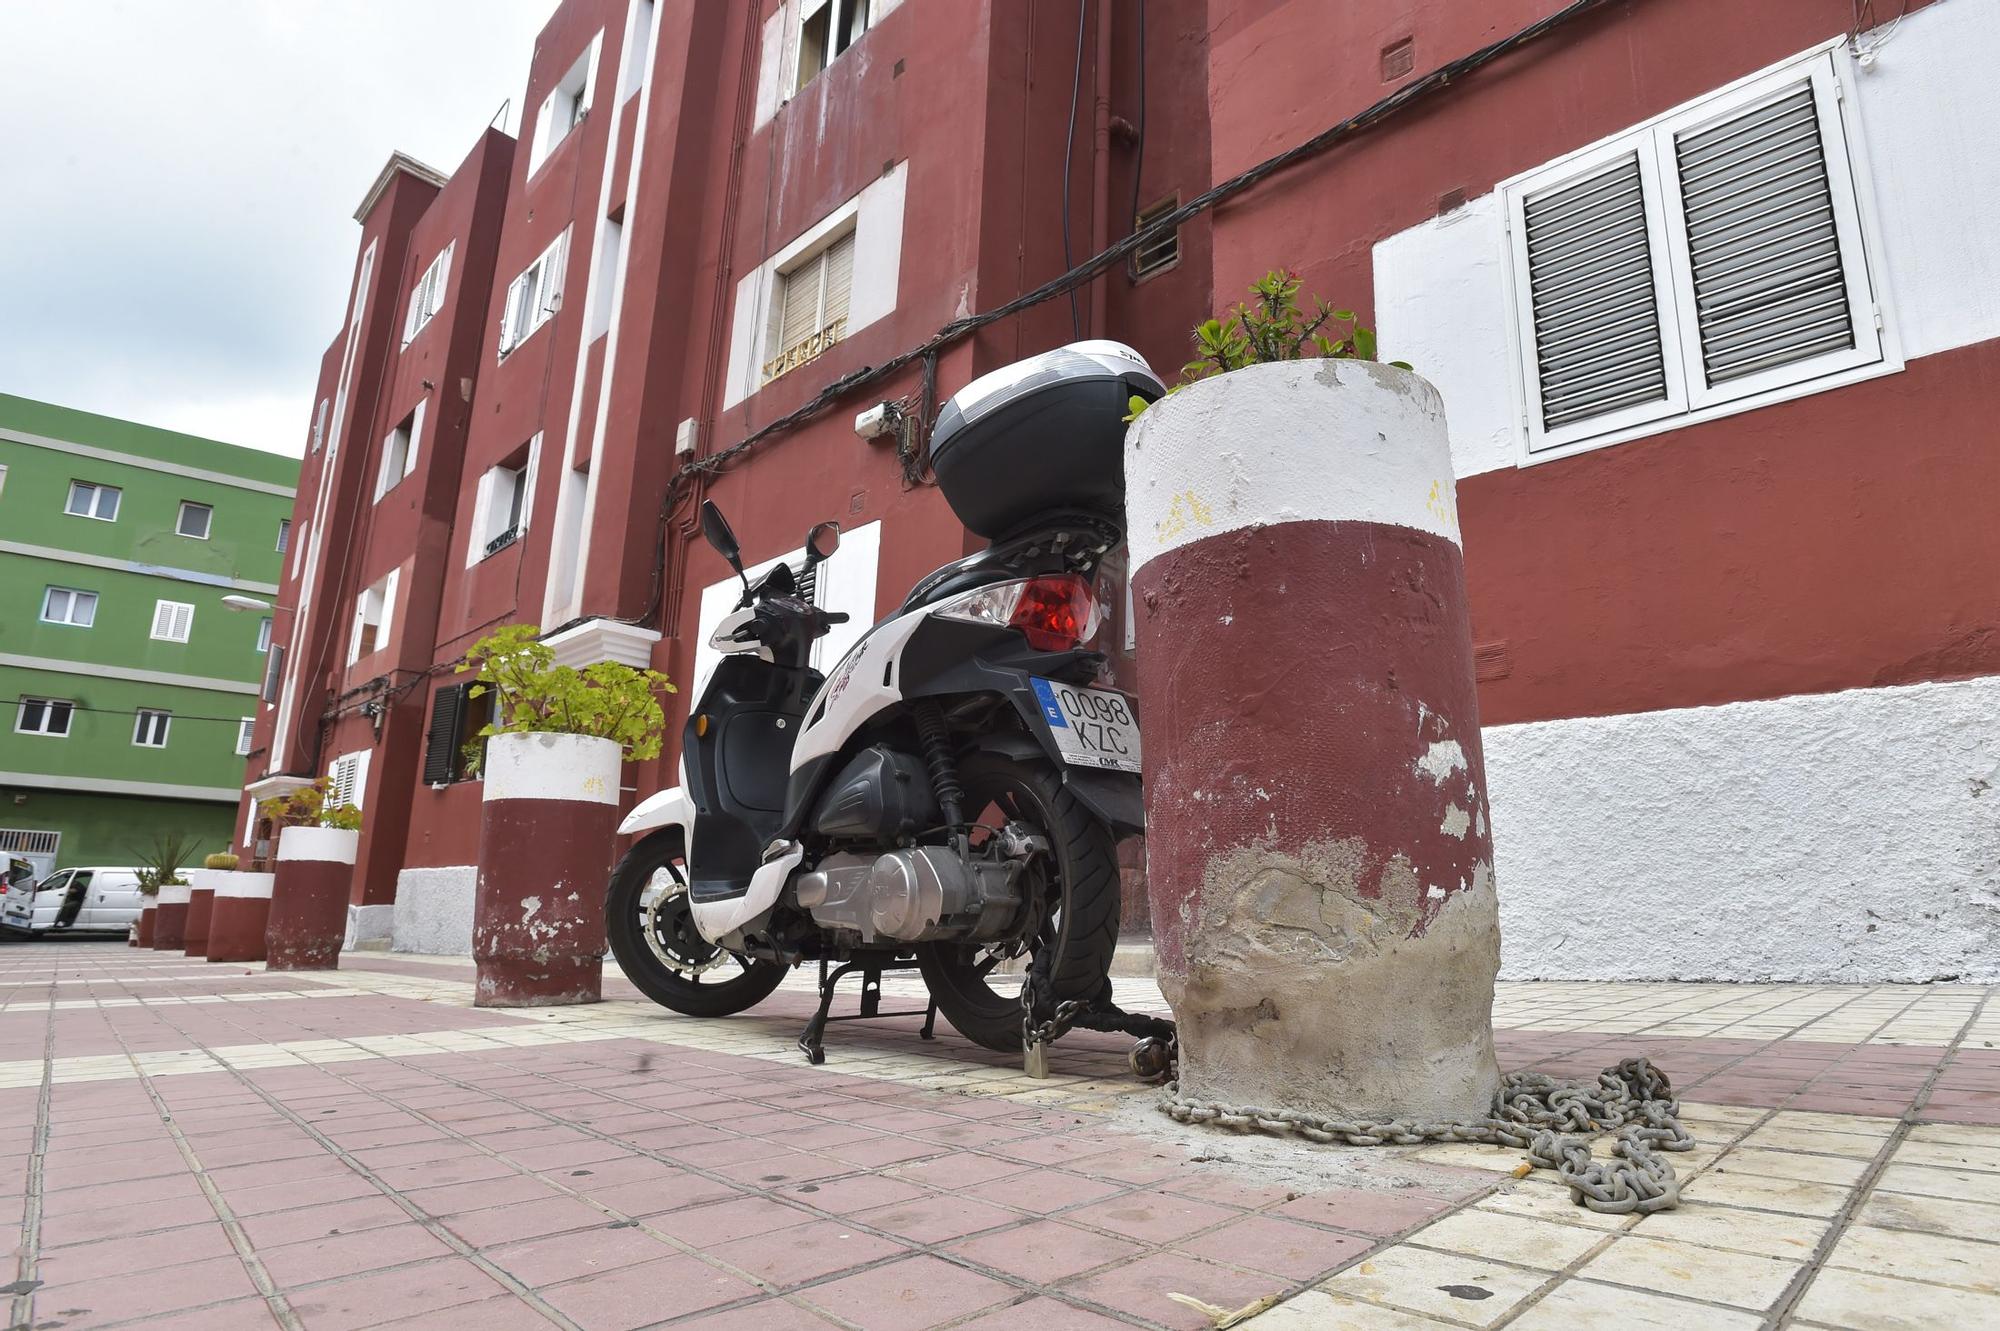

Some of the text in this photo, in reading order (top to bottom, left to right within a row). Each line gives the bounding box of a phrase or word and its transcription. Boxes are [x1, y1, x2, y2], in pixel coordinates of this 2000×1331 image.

[1047, 707, 1058, 719] E
[1061, 690, 1129, 725] 0098
[1071, 720, 1128, 754] KZC
